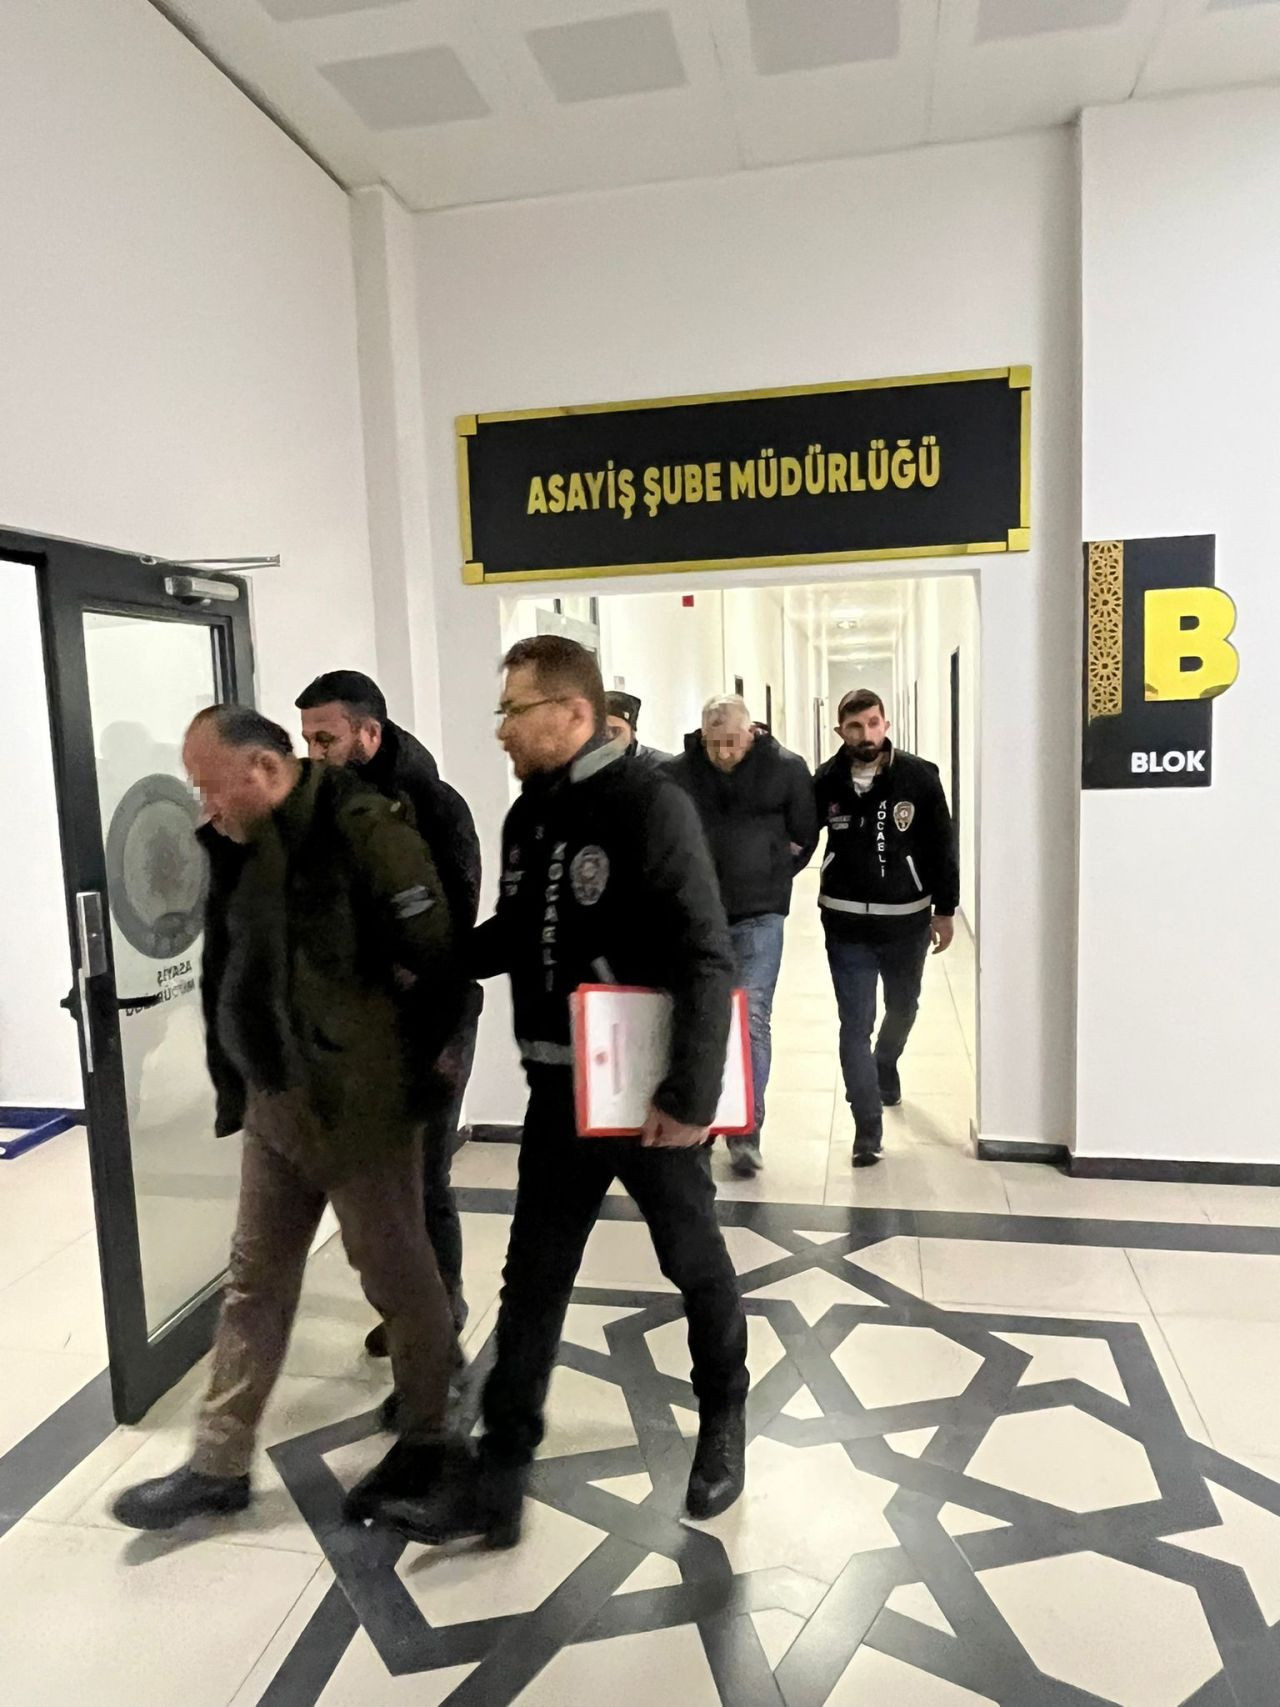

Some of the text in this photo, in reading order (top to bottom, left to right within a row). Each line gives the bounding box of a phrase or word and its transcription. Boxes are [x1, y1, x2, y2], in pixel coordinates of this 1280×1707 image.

[527, 435, 941, 519] ASAYİŞ ŞUBE MÜDÜRLÜĞÜ
[1144, 586, 1240, 702] B
[1131, 750, 1206, 774] BLOK
